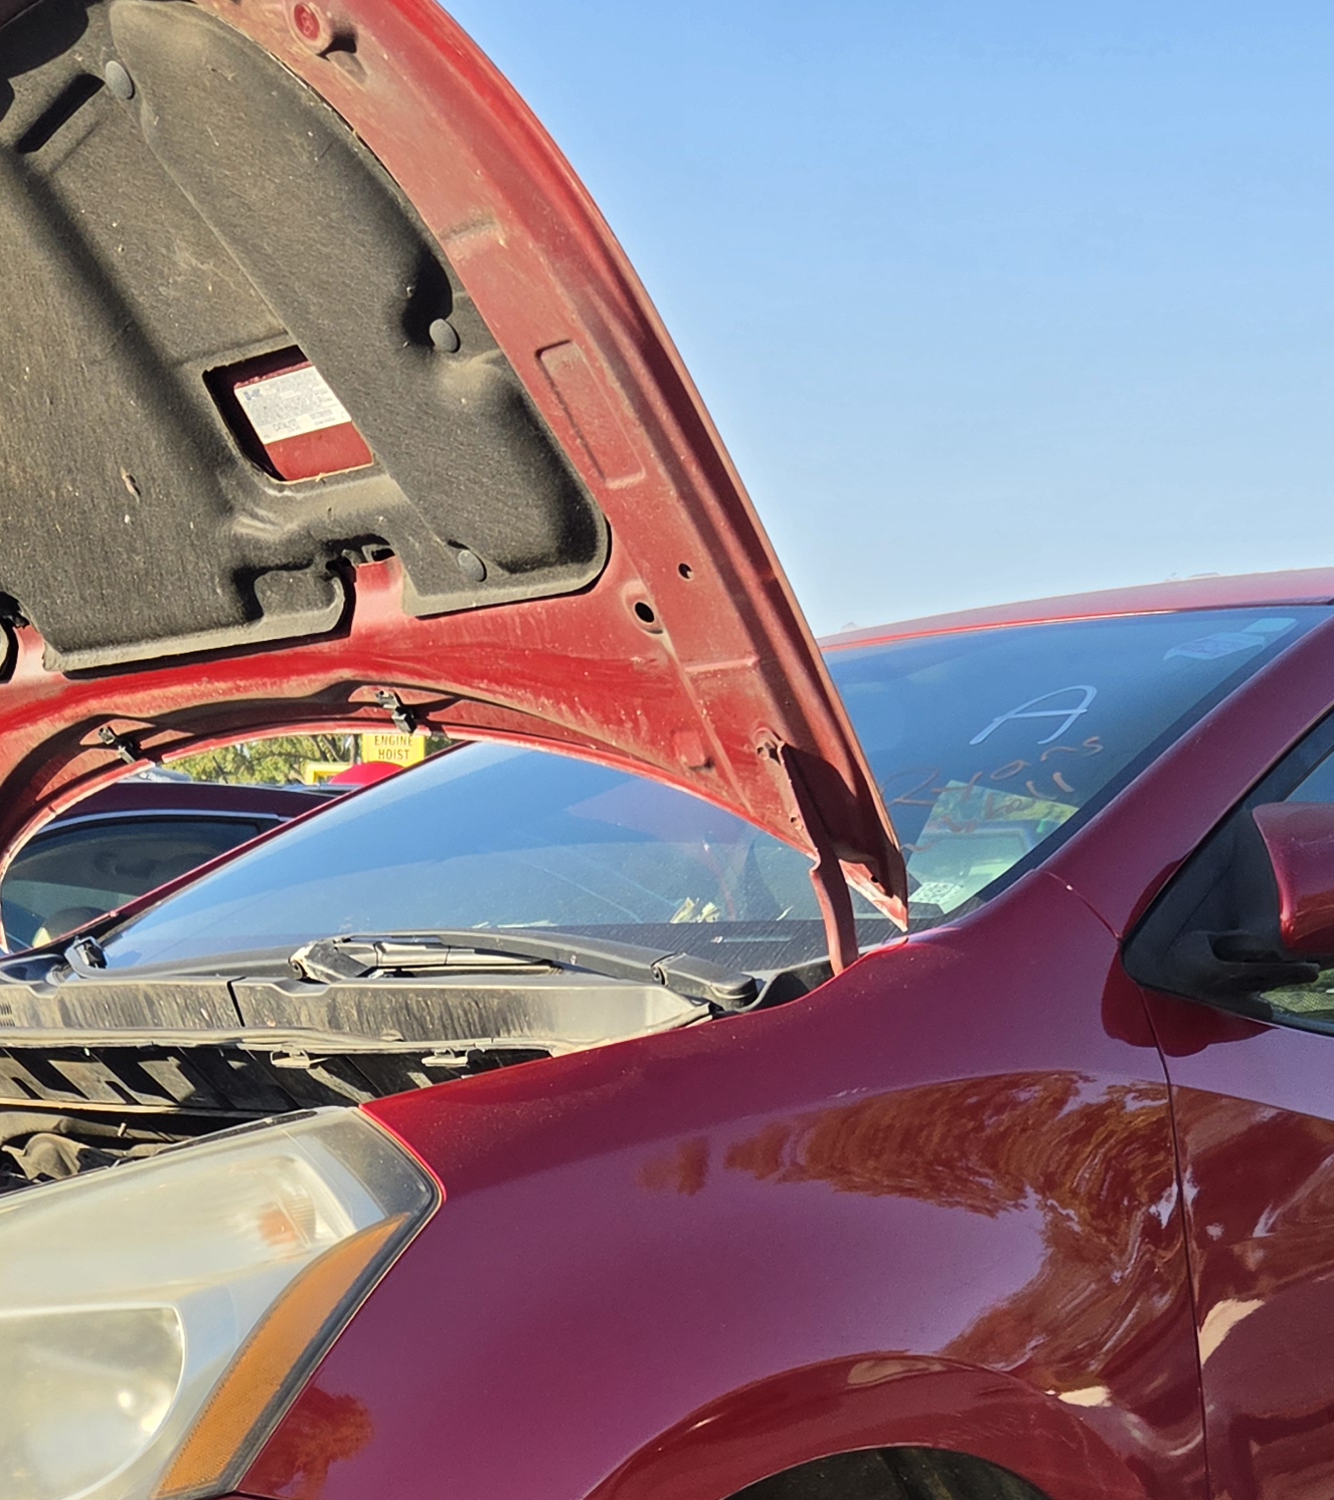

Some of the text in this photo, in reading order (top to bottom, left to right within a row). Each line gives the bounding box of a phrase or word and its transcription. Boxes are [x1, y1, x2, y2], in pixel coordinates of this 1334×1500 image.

[969, 684, 1098, 745] A
[374, 735, 413, 746] ENGINE
[378, 748, 410, 760] HOIST
